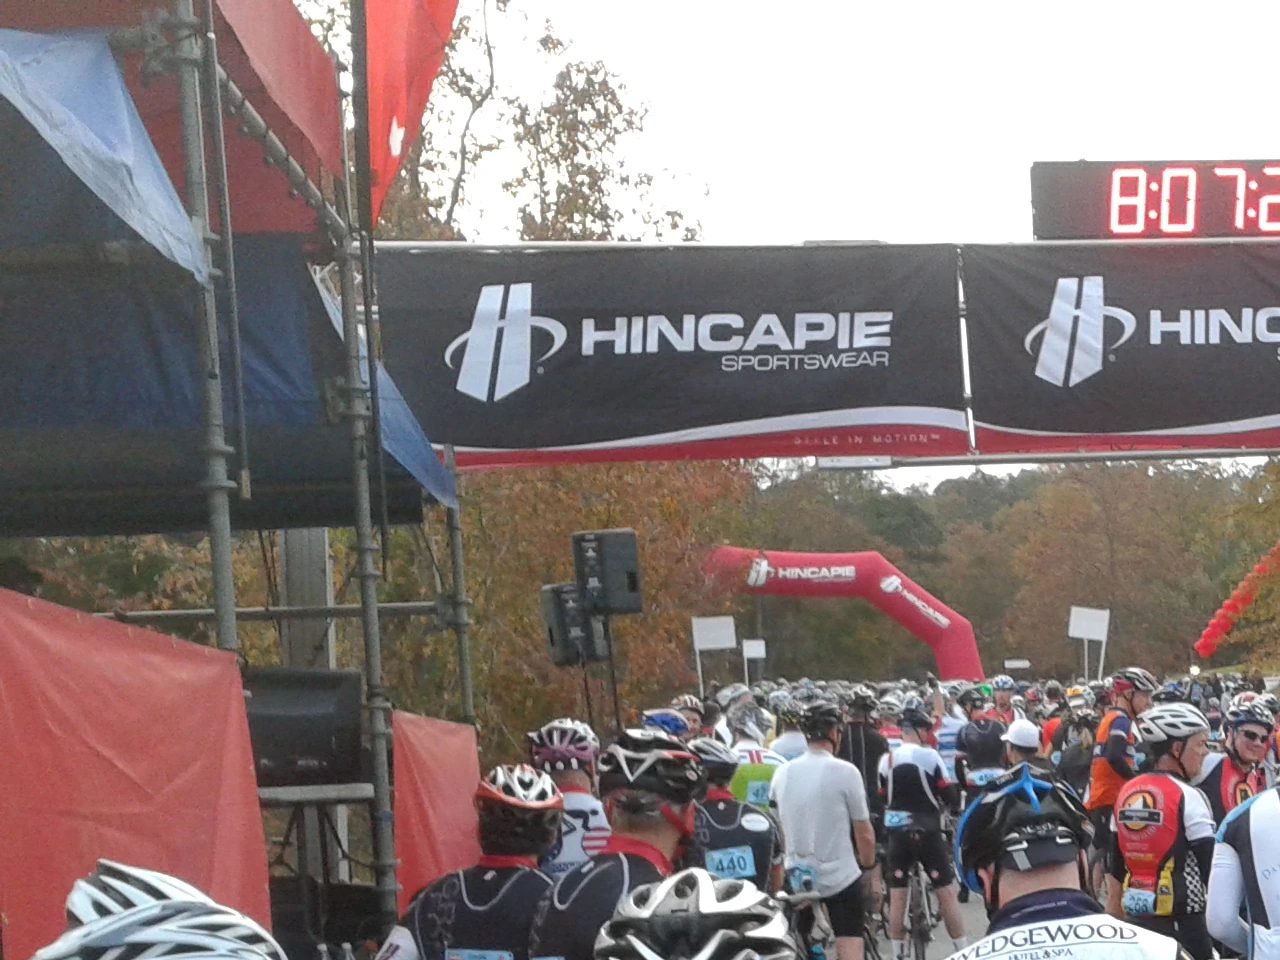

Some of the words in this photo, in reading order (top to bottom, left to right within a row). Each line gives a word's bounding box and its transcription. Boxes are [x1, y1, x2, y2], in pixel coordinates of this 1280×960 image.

[581, 311, 894, 357] HINCAPIE
[720, 350, 890, 372] SPORTSWEAR
[715, 855, 747, 873] 440
